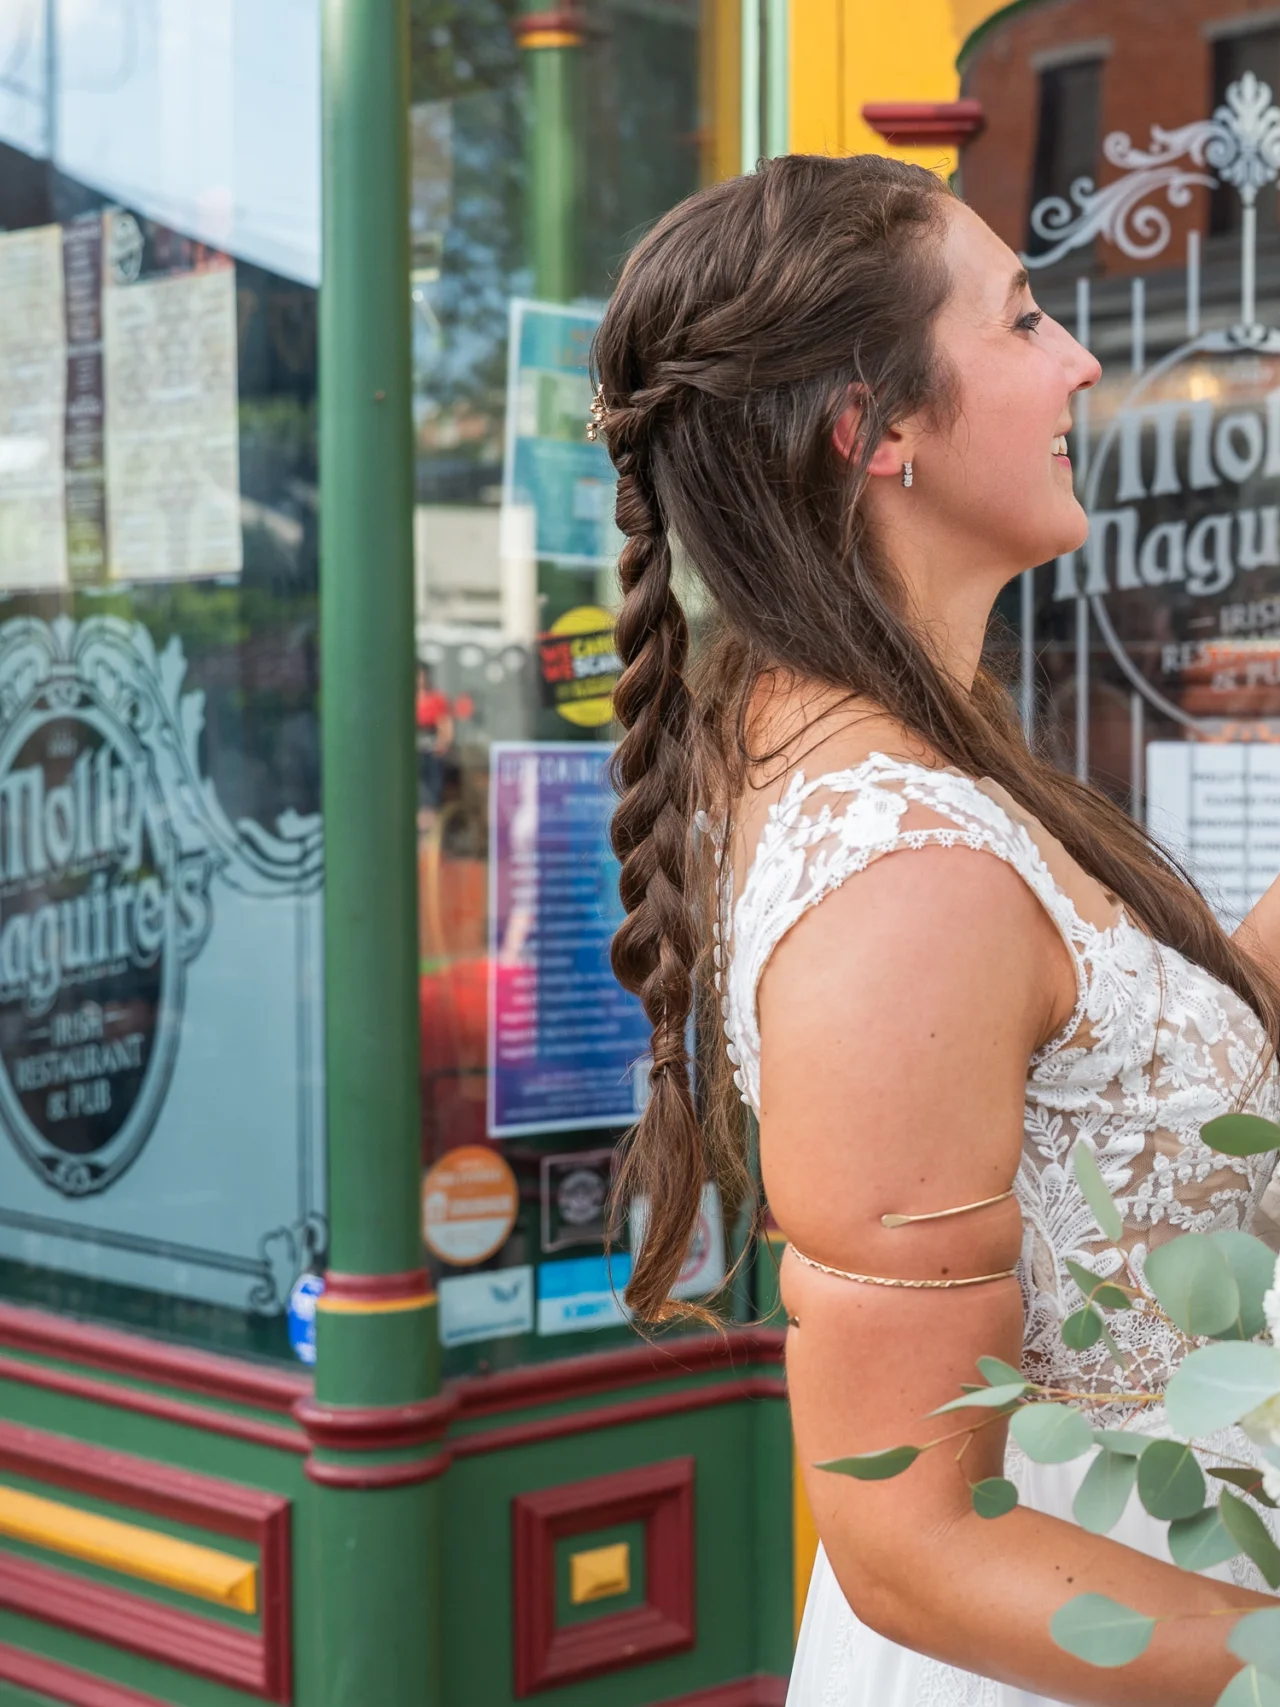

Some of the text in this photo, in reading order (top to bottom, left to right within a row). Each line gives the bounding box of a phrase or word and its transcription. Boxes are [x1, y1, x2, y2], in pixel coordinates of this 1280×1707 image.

[0, 862, 208, 998] aguire's
[16, 1034, 145, 1090] RESTAURANT
[47, 1078, 111, 1122] & PUB
